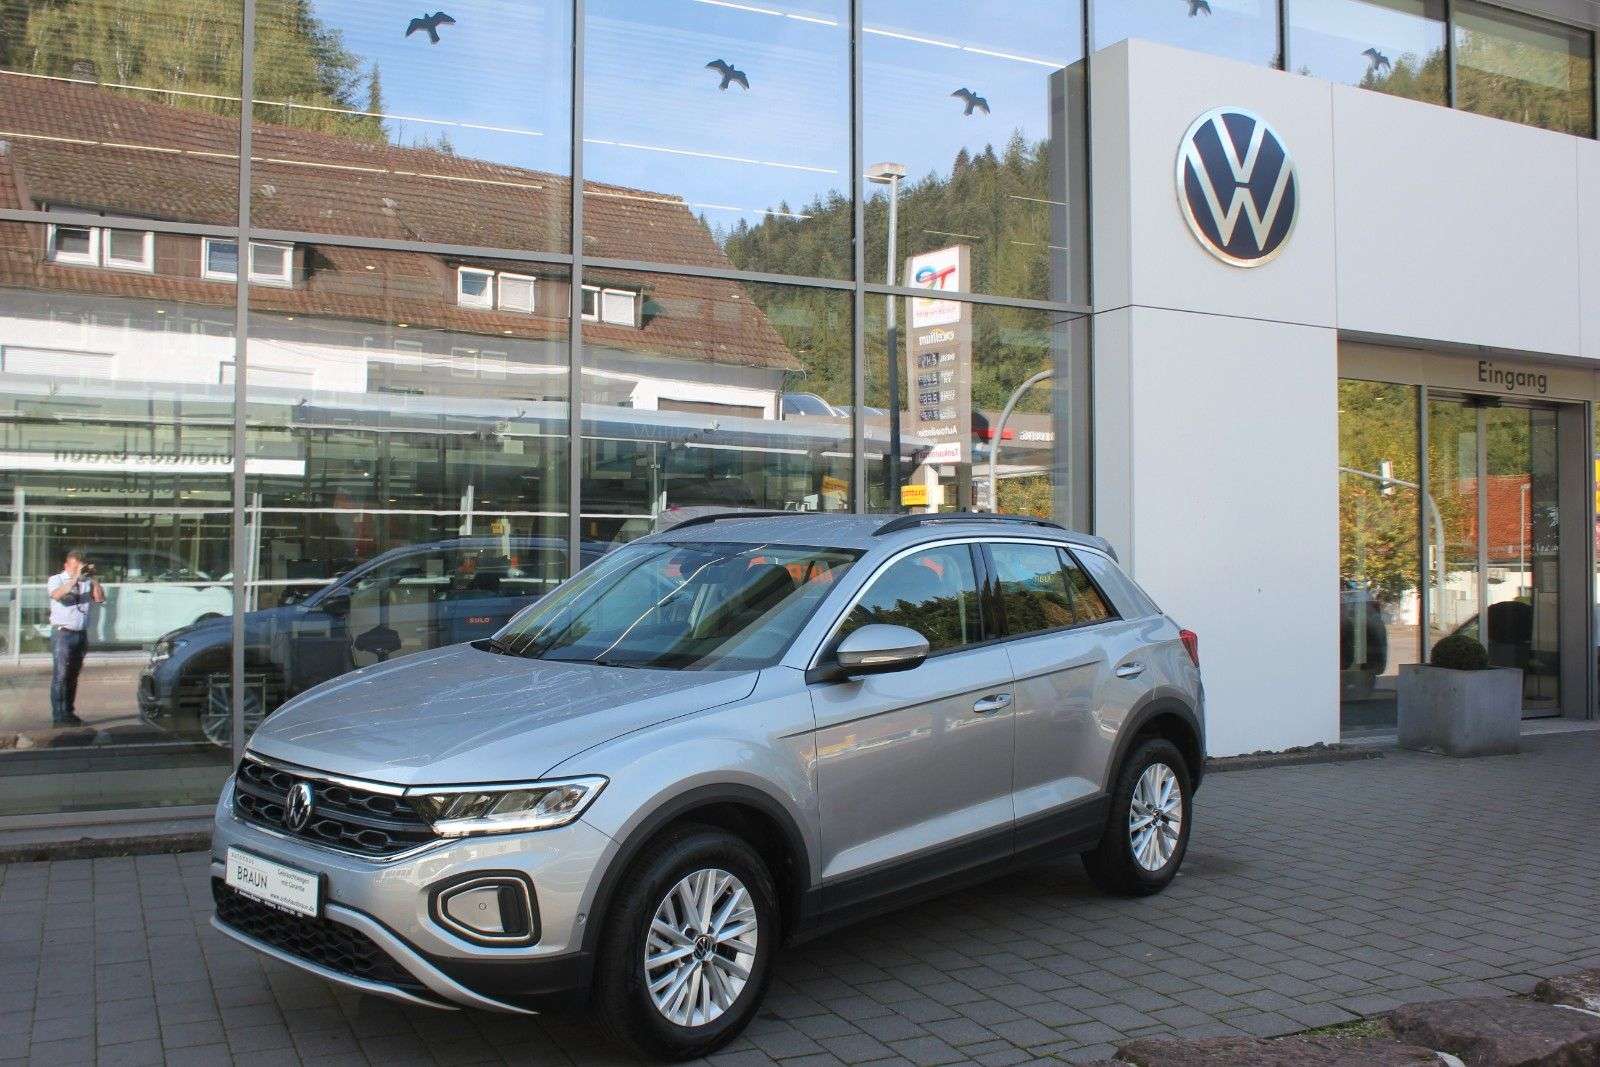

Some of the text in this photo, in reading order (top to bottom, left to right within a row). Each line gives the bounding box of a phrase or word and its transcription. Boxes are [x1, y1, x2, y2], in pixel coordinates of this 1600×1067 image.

[1176, 106, 1300, 268] VW
[1478, 361, 1547, 393] Eingang
[237, 866, 268, 888] BRAUN
